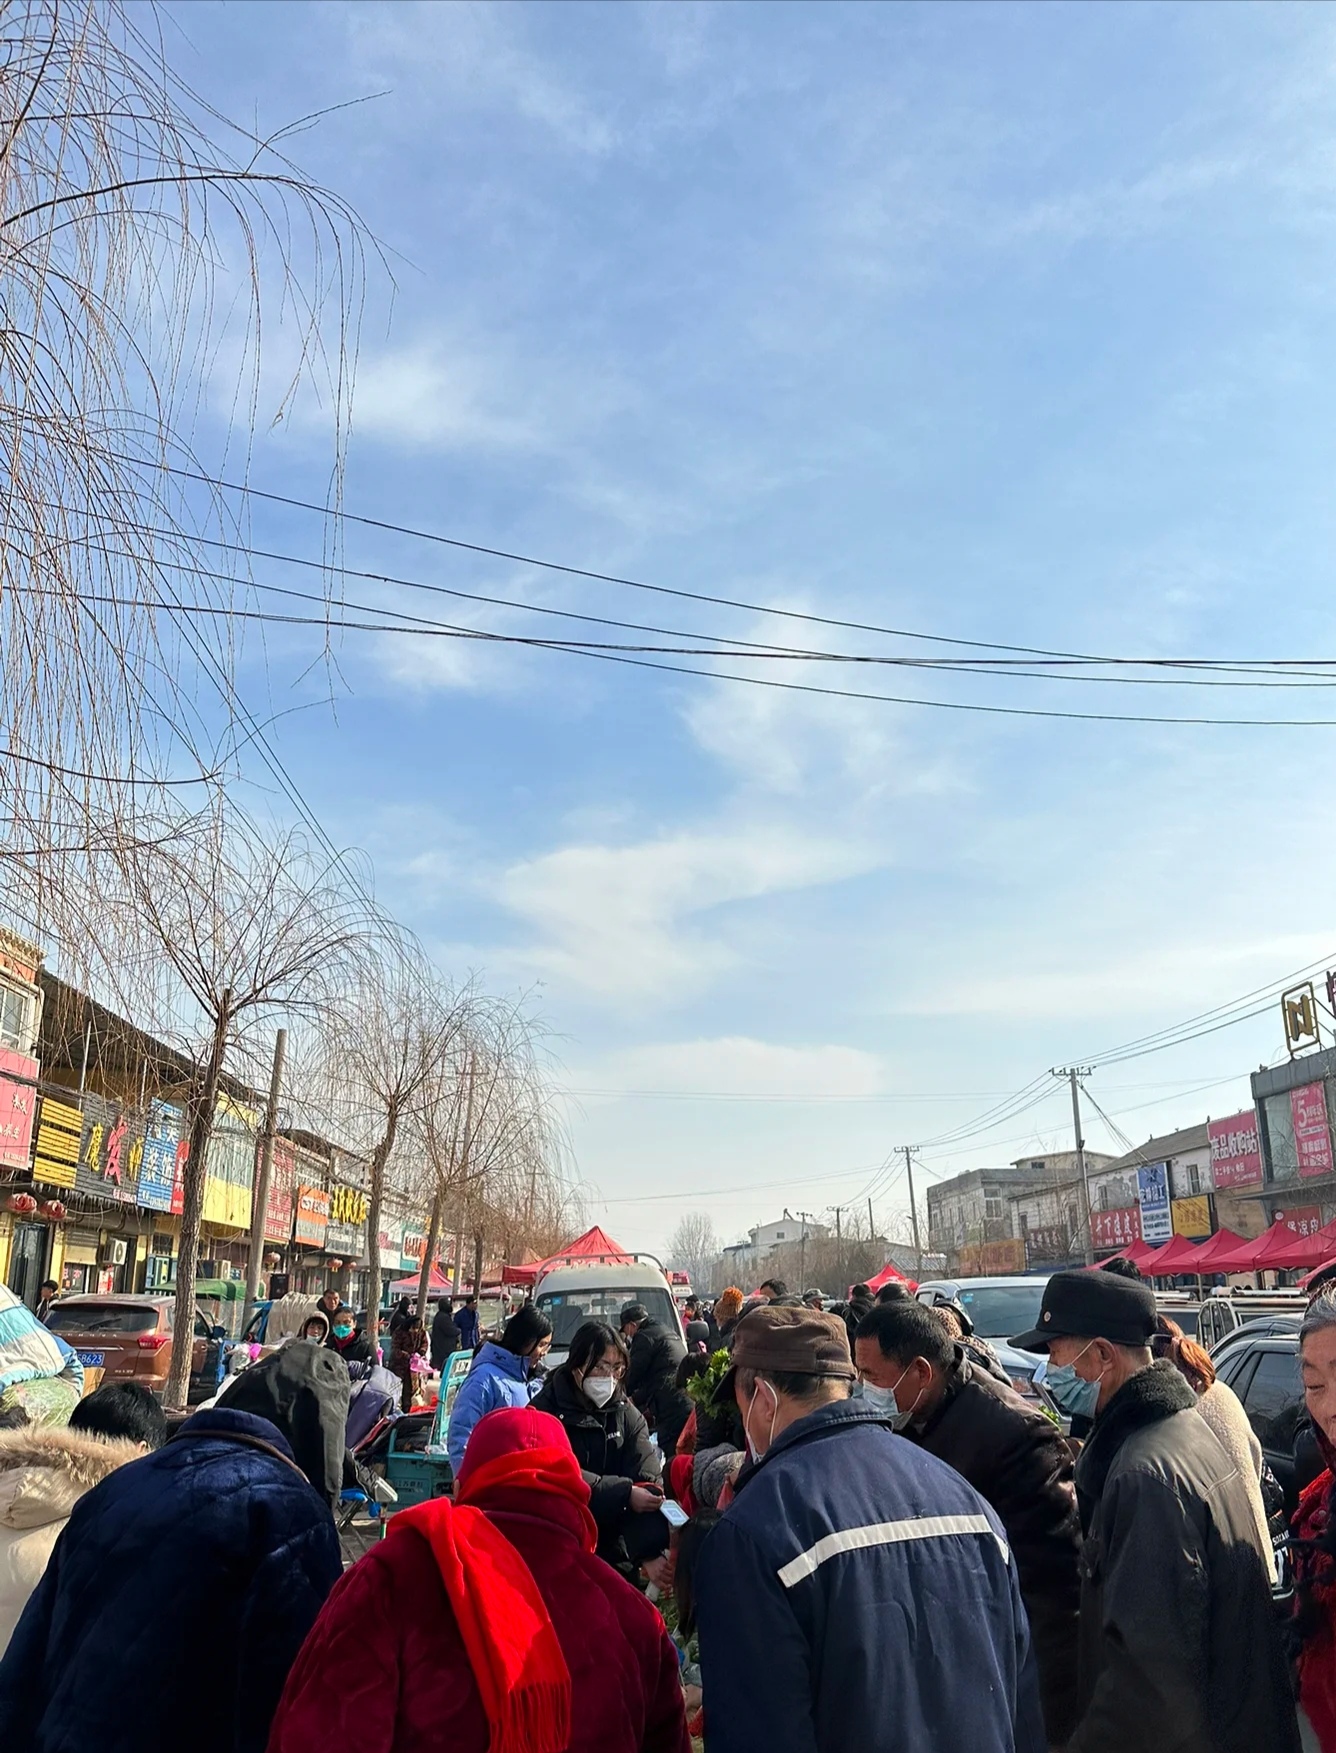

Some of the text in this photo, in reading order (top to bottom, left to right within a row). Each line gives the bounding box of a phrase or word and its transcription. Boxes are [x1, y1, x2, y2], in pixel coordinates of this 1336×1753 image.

[1210, 1127, 1257, 1161] 废品收购站
